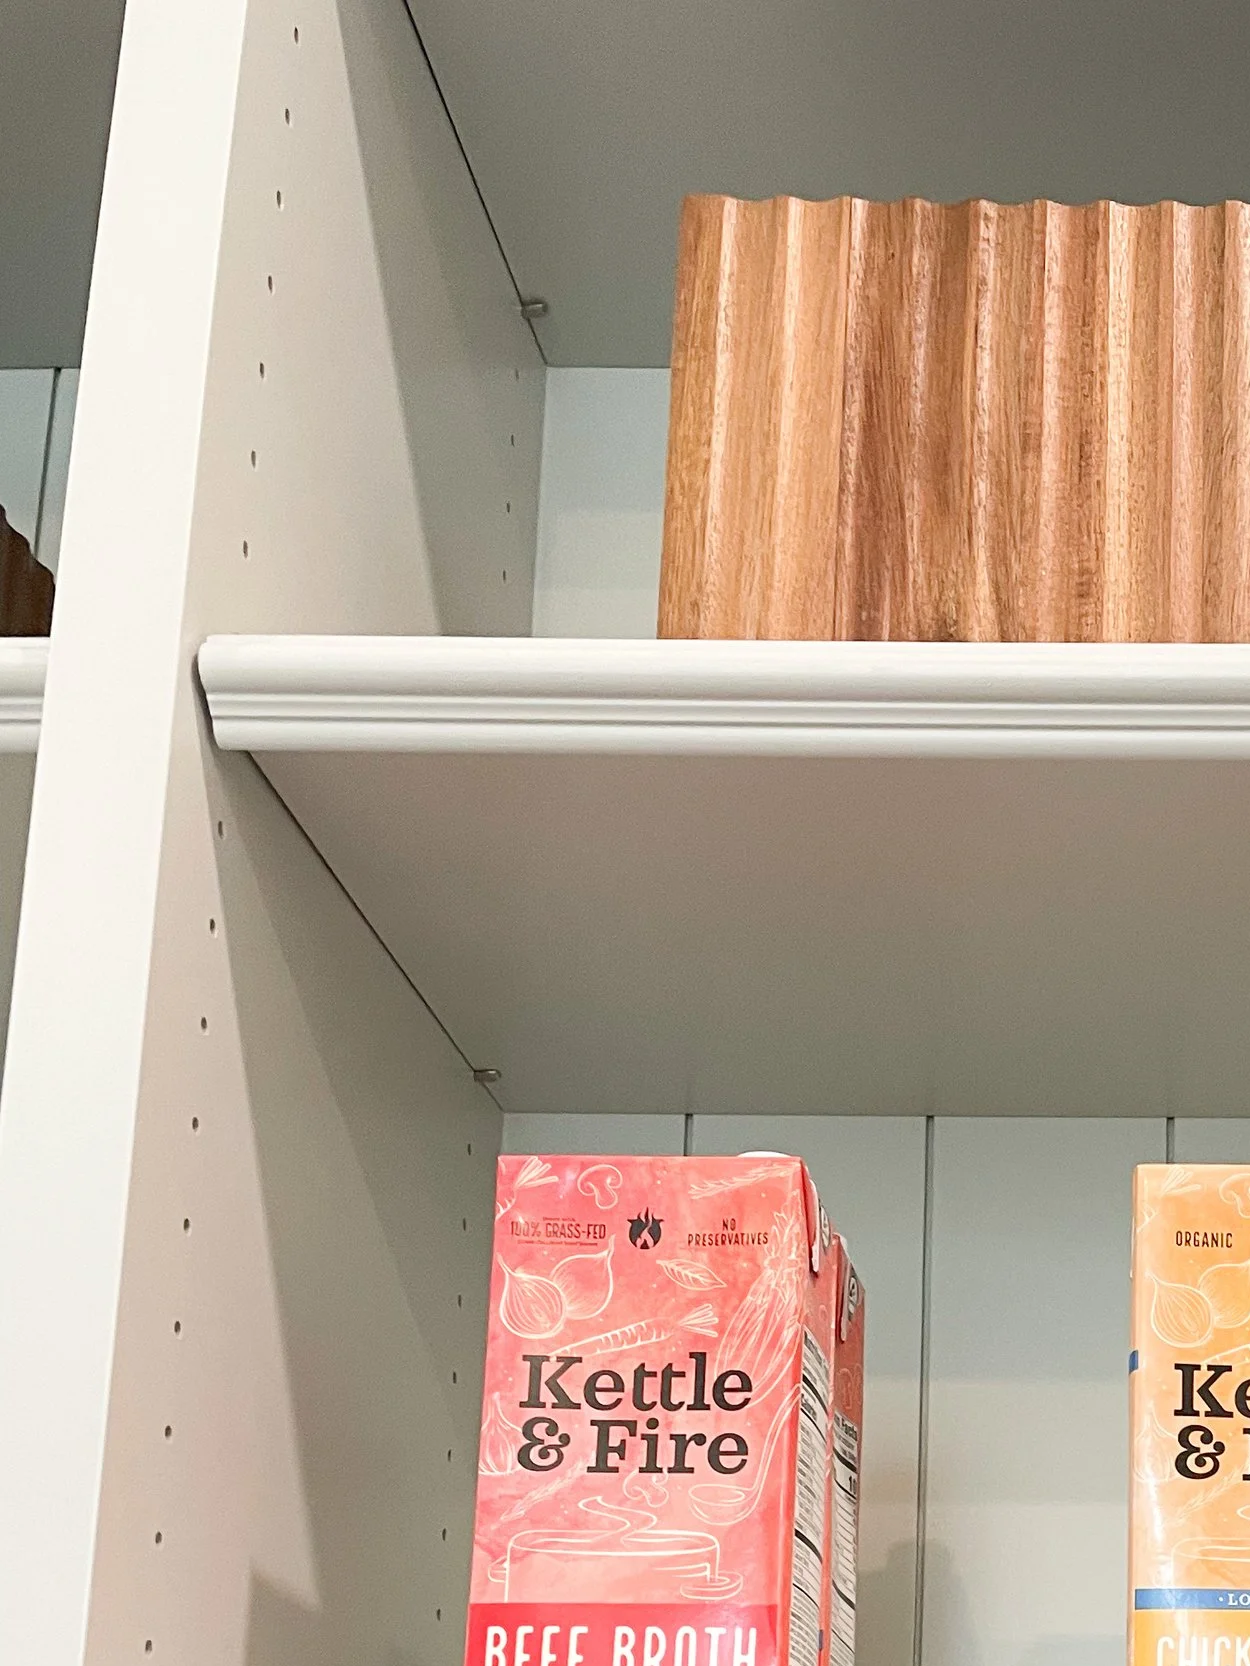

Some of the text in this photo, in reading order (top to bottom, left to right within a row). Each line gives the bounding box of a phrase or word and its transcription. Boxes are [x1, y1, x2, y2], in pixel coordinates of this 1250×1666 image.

[545, 1221, 606, 1239] GRASS-FED
[722, 1218, 736, 1231] NO
[688, 1232, 769, 1246] PRESERVATIVES
[1175, 1231, 1233, 1248] ORGANIC
[519, 1352, 753, 1411] Kettle
[517, 1417, 749, 1474] & Fire
[1174, 1425, 1226, 1480] &
